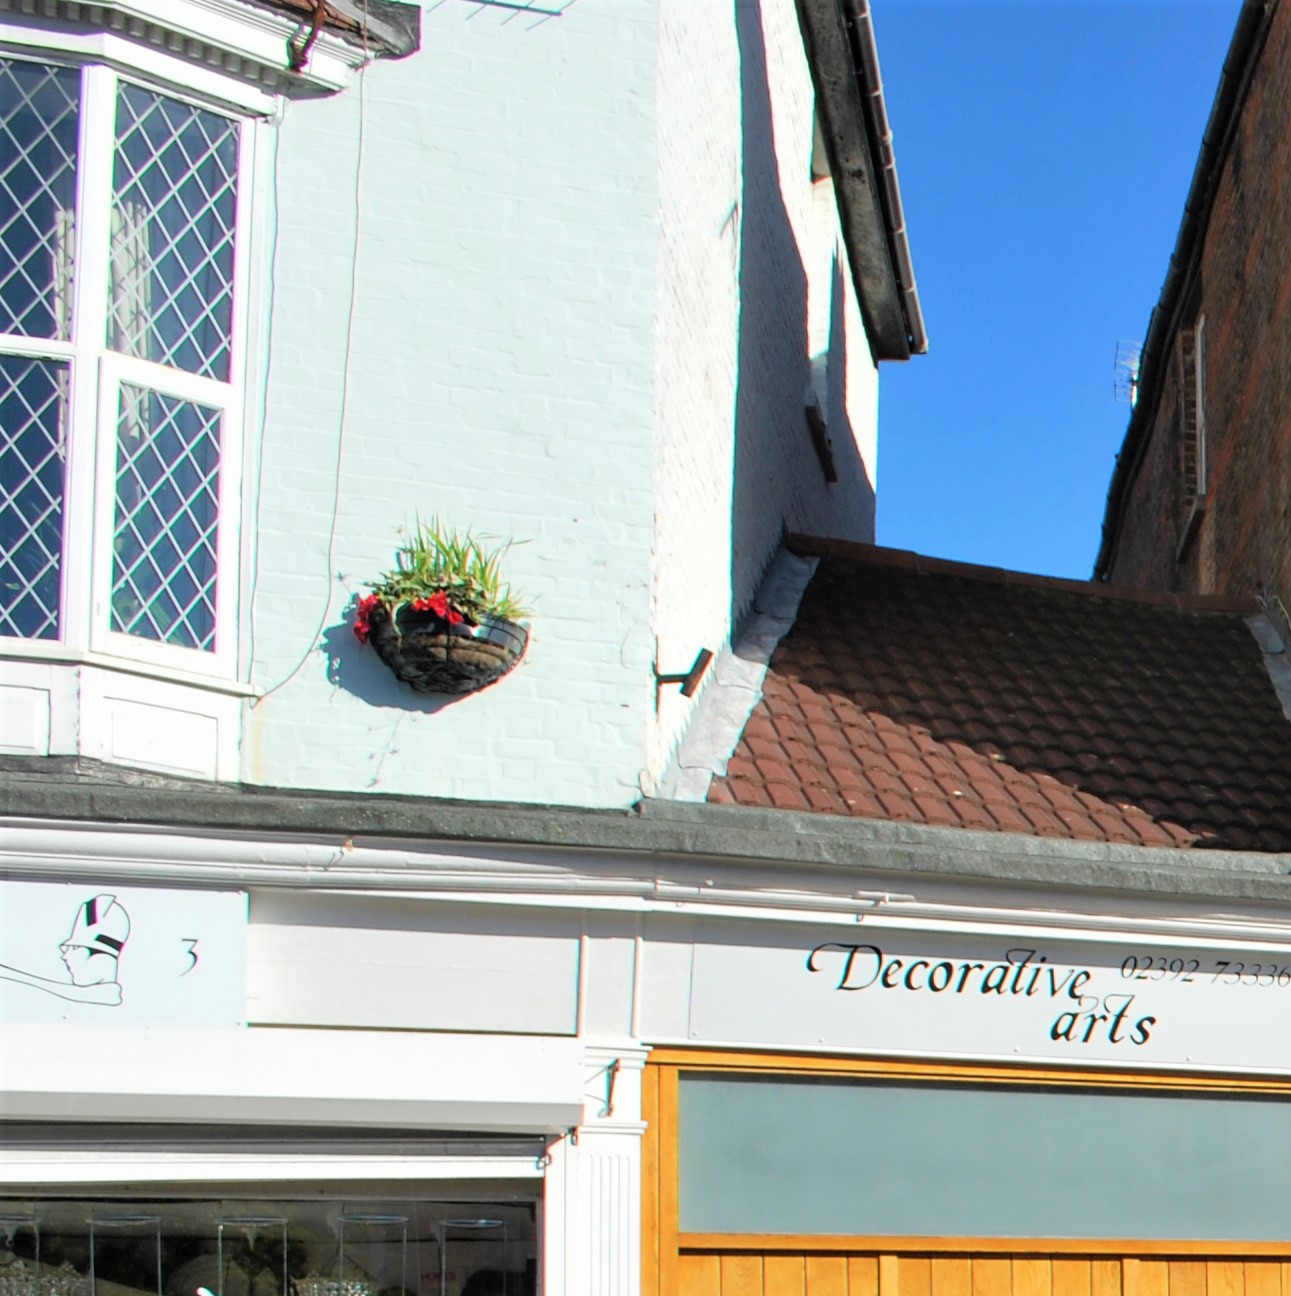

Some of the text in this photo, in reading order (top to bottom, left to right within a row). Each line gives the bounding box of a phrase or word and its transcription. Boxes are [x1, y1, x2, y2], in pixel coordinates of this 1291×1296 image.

[180, 938, 199, 977] 3
[806, 943, 1098, 1013] Decorative
[1121, 955, 1200, 984] 02392
[1050, 994, 1157, 1045] arts
